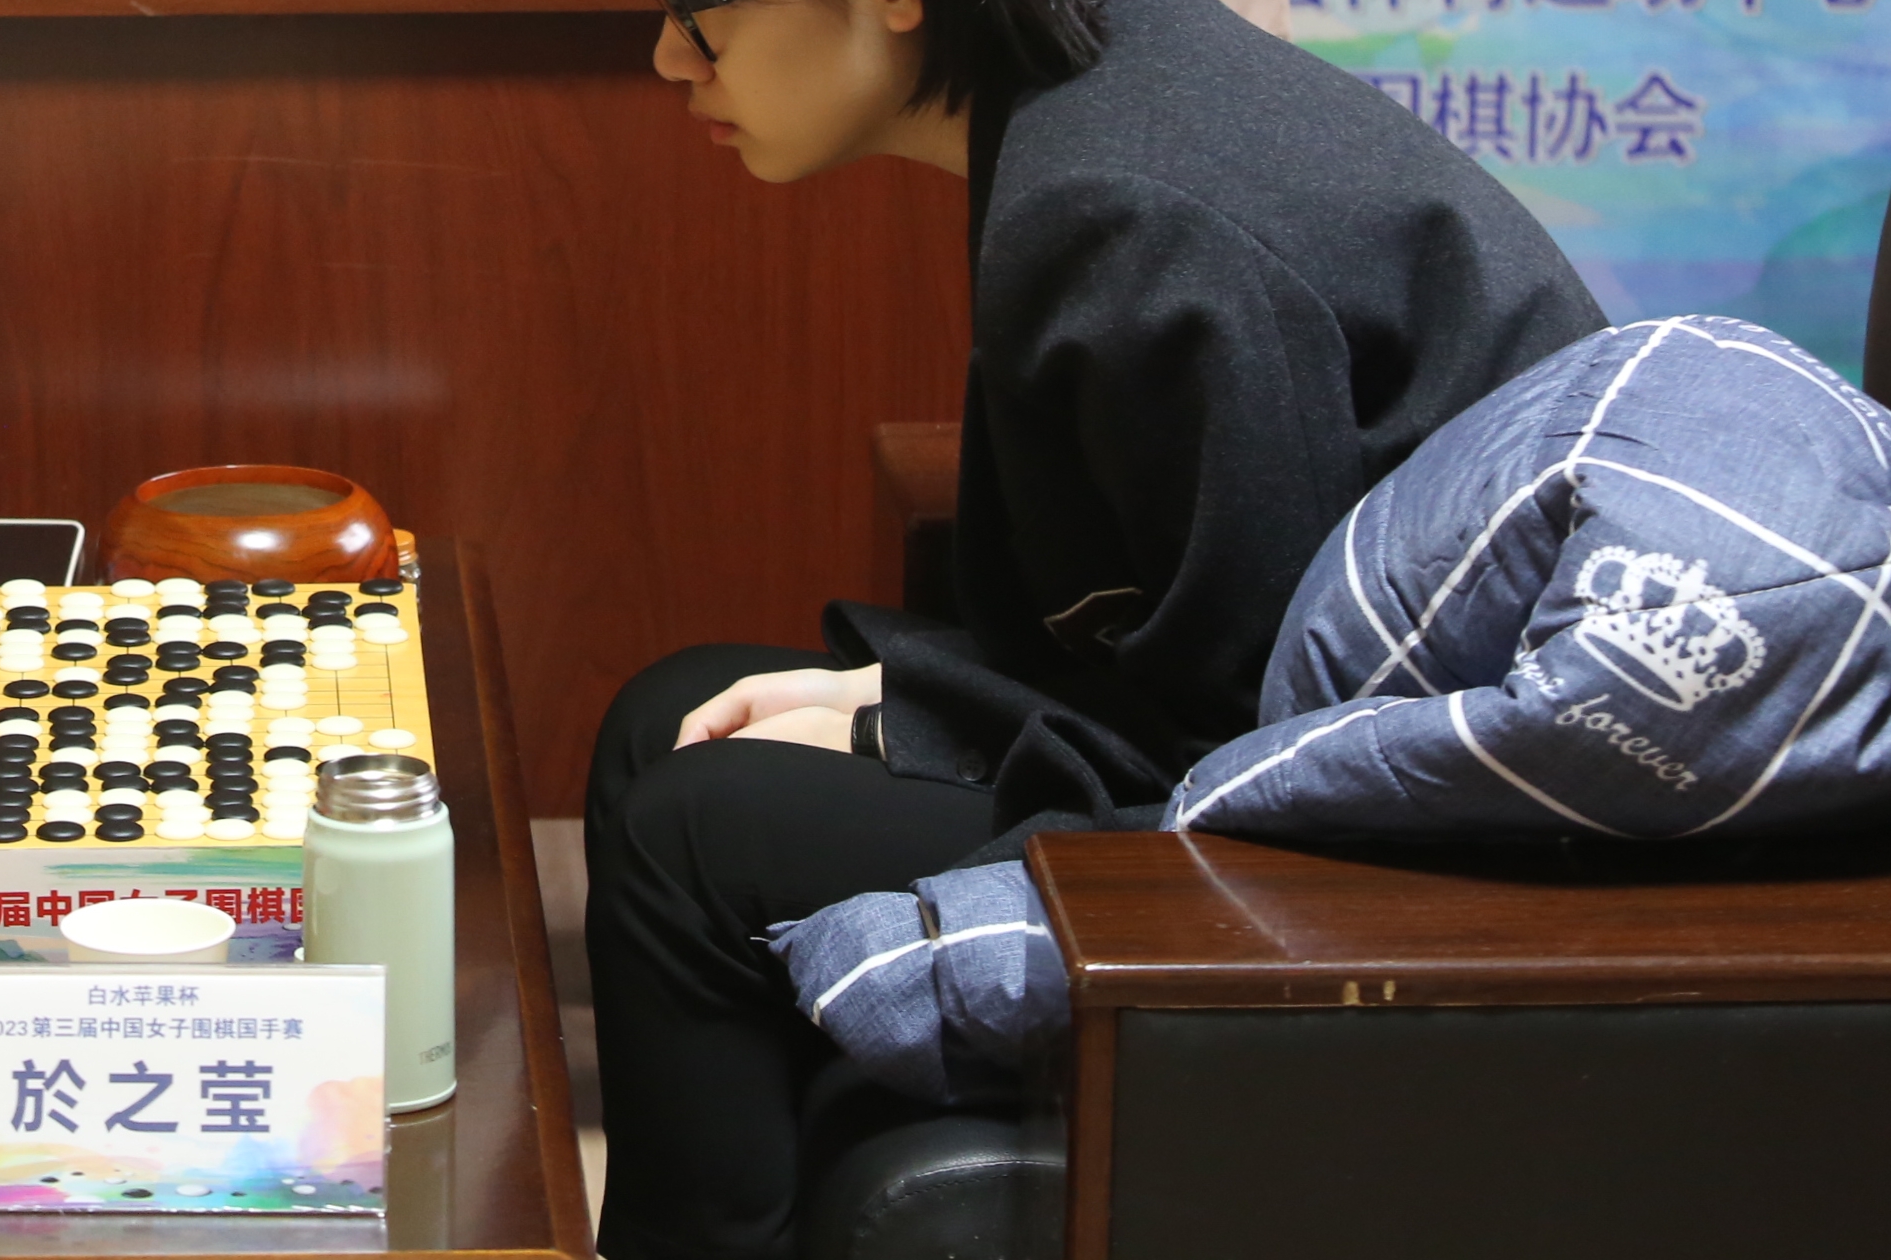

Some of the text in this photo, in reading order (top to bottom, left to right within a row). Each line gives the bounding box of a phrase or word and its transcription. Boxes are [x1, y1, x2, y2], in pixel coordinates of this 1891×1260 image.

[87, 984, 200, 1008] 白水苹果杯
[10, 1058, 274, 1135] 於之莹
